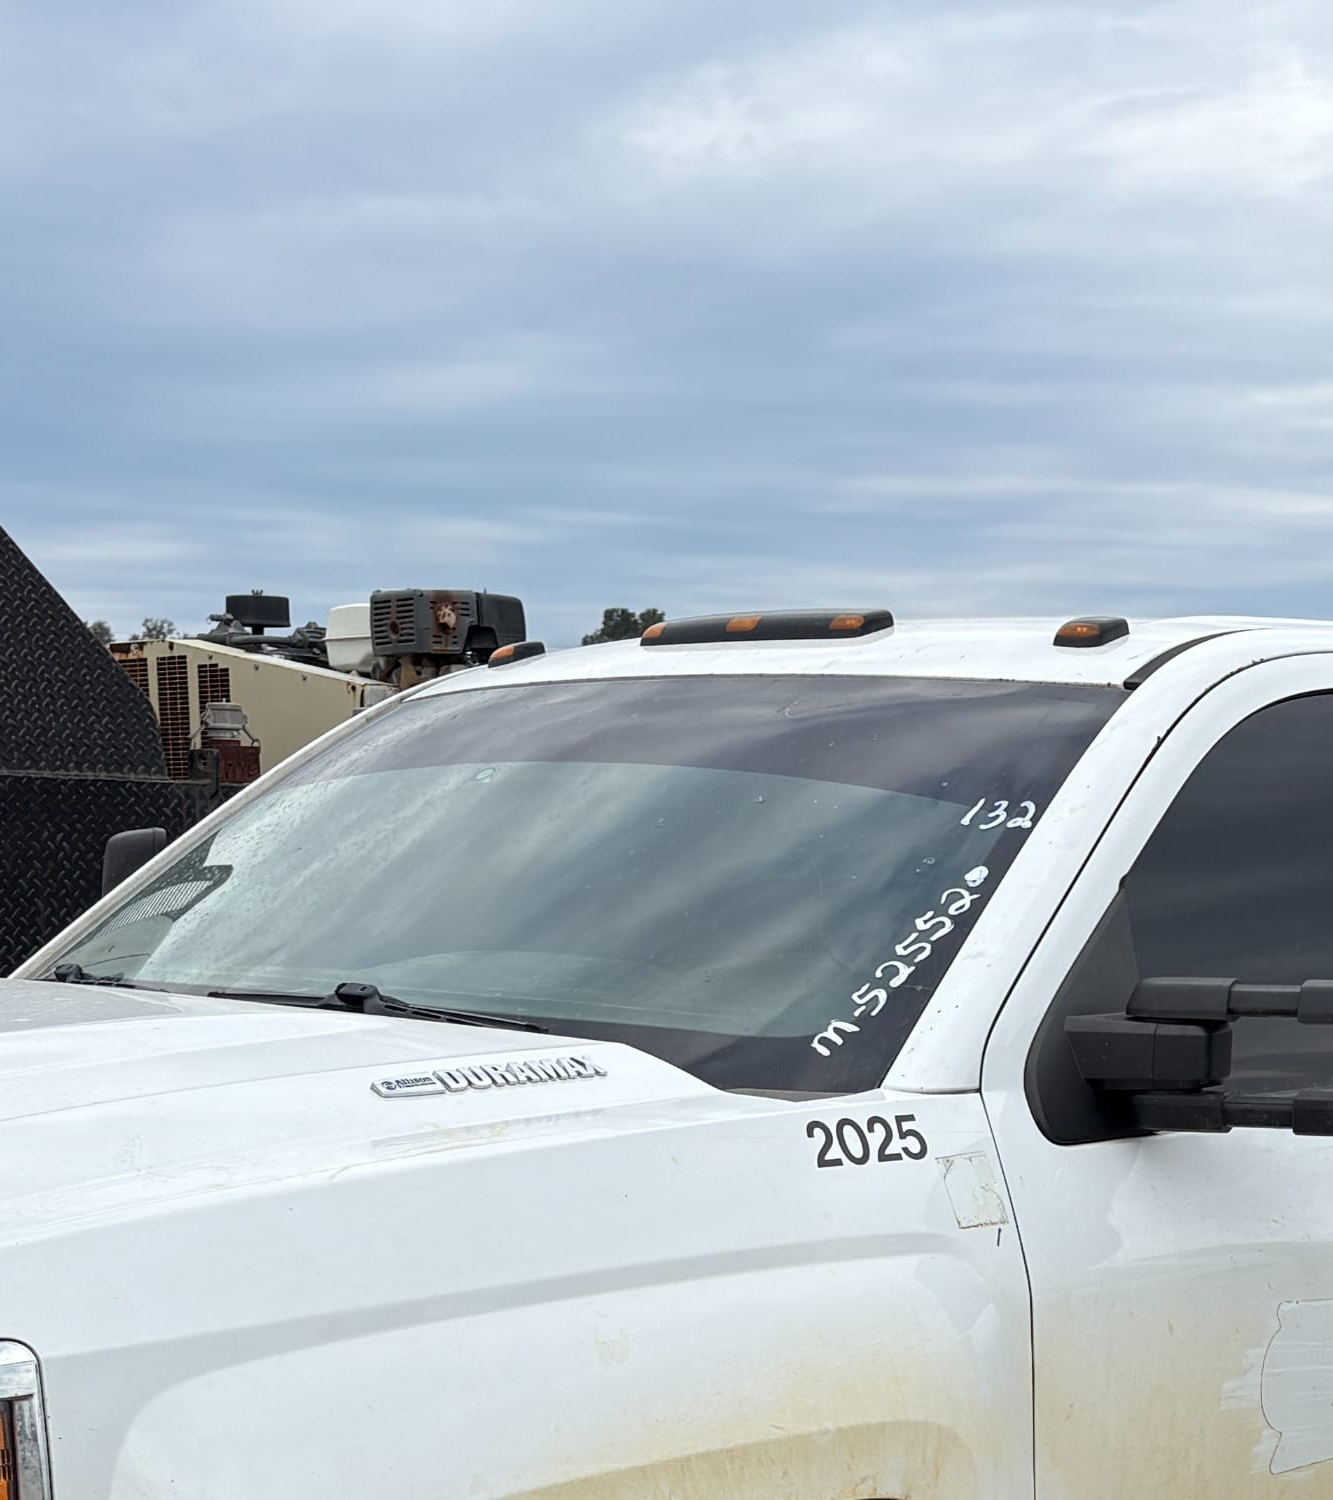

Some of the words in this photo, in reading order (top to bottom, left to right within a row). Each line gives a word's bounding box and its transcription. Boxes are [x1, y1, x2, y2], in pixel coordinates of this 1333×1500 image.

[960, 797, 1036, 830] 132
[433, 1055, 608, 1092] DURAMAX
[806, 1114, 928, 1168] 2025
